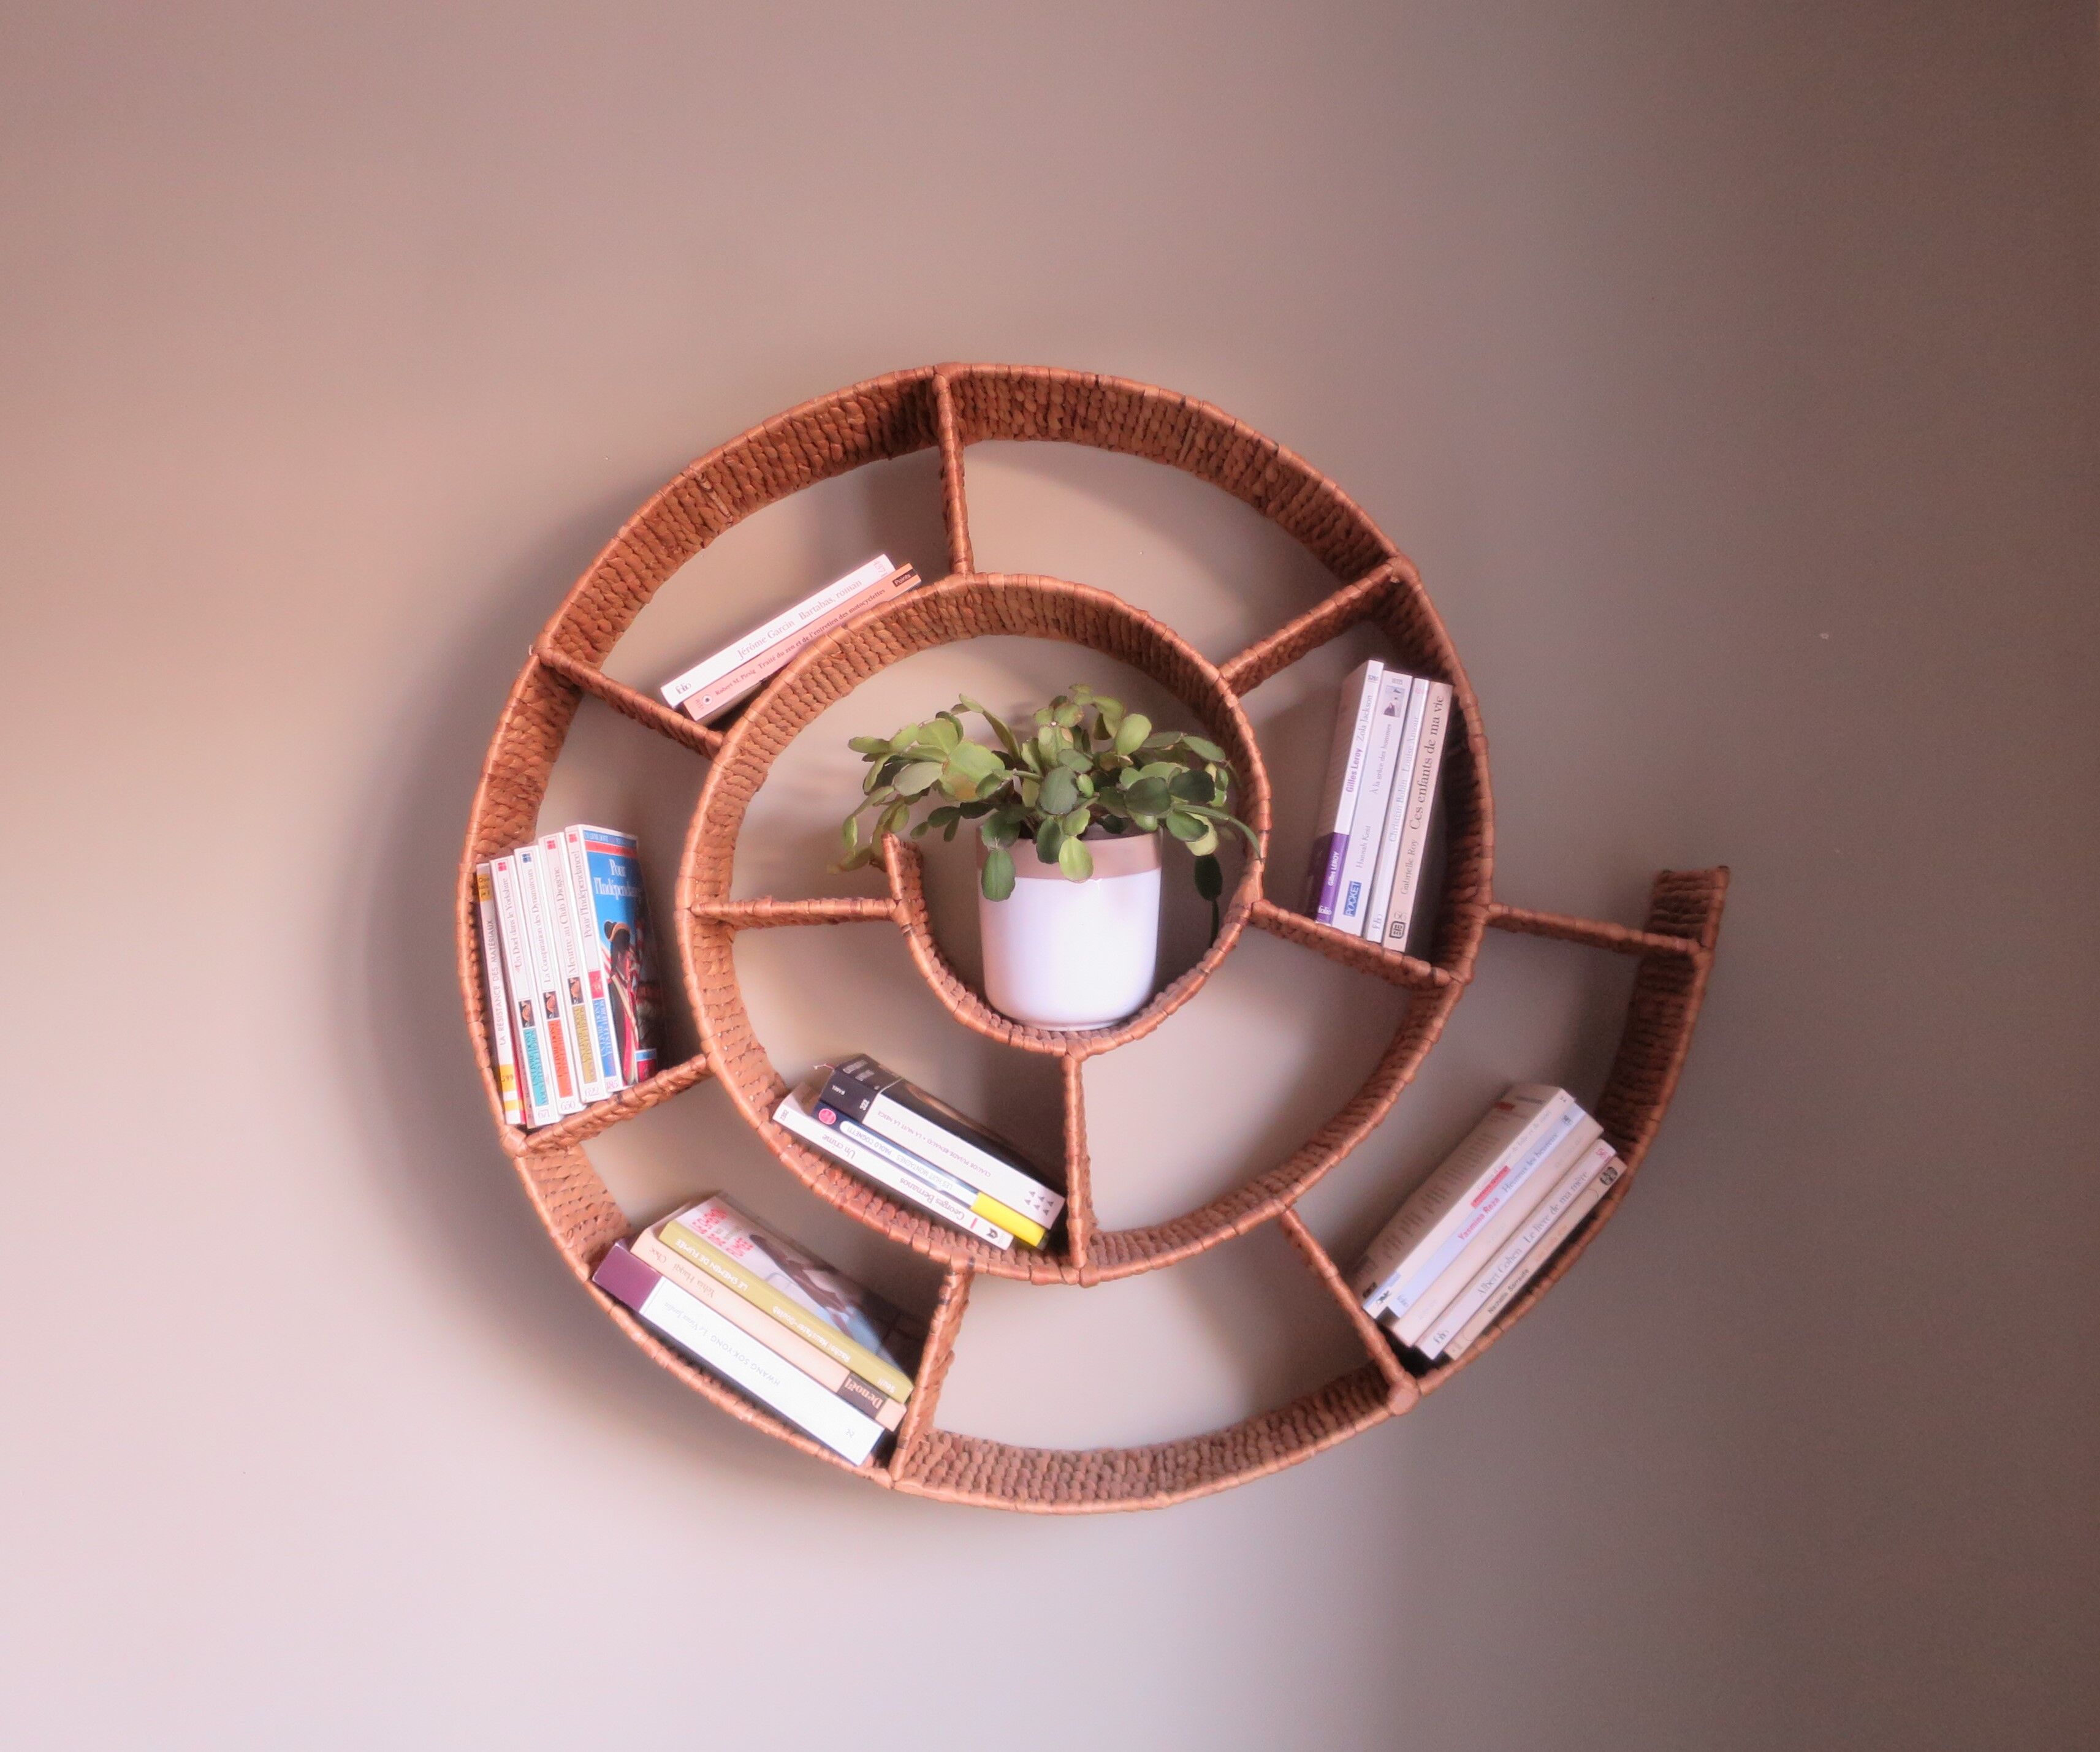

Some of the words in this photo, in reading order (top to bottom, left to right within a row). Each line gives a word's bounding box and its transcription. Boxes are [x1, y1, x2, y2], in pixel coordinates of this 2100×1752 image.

[798, 595, 835, 620] Bartabas,
[835, 580, 861, 599] roman
[758, 656, 775, 669] Traité
[785, 644, 795, 653] zen
[808, 617, 839, 638] l'entretien
[838, 611, 848, 620] des
[848, 588, 886, 614] motocyclettes
[736, 635, 767, 661] Jérôme
[766, 619, 795, 639] Garcin
[714, 682, 733, 696] Robert
[1360, 695, 1373, 722] Jackson
[1432, 695, 1444, 713] vie
[1356, 724, 1367, 741] Zola
[1379, 723, 1391, 749] hommes
[1429, 716, 1440, 735] ma
[1377, 750, 1386, 761] des
[1423, 739, 1436, 754] de
[1350, 748, 1363, 769] Leroy
[1345, 770, 1357, 792] Gilles
[1415, 757, 1432, 803] enfants
[1388, 805, 1403, 842] Christian
[1396, 779, 1407, 803] Bobin
[1402, 745, 1413, 772] Louise
[1409, 805, 1423, 830] Ces
[1361, 825, 1371, 841] Kent
[1355, 842, 1367, 868] Hannah
[1407, 839, 1418, 855] Roy
[609, 859, 626, 876] Pour
[1329, 851, 1339, 870] LEROY
[552, 867, 566, 901] Diogène
[1400, 859, 1413, 895] Gabrielle
[501, 878, 512, 911] Yorkshire
[1345, 881, 1360, 916] POCKET
[558, 903, 568, 925] Club
[508, 919, 517, 935] dans
[563, 925, 571, 937] au
[582, 917, 592, 938] Pour
[485, 919, 497, 962] MATÉRIAUX
[536, 927, 549, 972] Conspiration
[565, 939, 576, 974] Meurtre
[543, 973, 551, 983] La
[492, 985, 504, 1031] RÉSISTANCE
[499, 1036, 506, 1045] LA
[846, 1126, 874, 1145] COGNETTI
[900, 1123, 914, 1134] NUIT
[821, 1134, 843, 1150] crime
[842, 1146, 856, 1159] Un
[873, 1141, 892, 1155] PAOLO
[969, 1162, 991, 1177] CLAUDE
[898, 1177, 935, 1204] Bernanos
[942, 1180, 953, 1190] LES
[934, 1197, 965, 1221] Georges
[1458, 1212, 1485, 1240] Yasmina
[1482, 1196, 1500, 1214] Reza
[674, 1238, 700, 1259] FUMÉE
[1477, 1272, 1499, 1295] Albert
[1496, 1246, 1522, 1273] Cohen
[1523, 1231, 1535, 1243] Le
[1532, 1213, 1550, 1232] livre
[1548, 1202, 1559, 1215] de
[1559, 1191, 1572, 1204] ma
[698, 1254, 710, 1265] DE
[737, 1280, 748, 1291] LE
[827, 1343, 851, 1363] Rachel
[749, 1362, 780, 1386] HWANG
[843, 1378, 883, 1409] Denoël
[877, 1378, 896, 1393] Seuil
